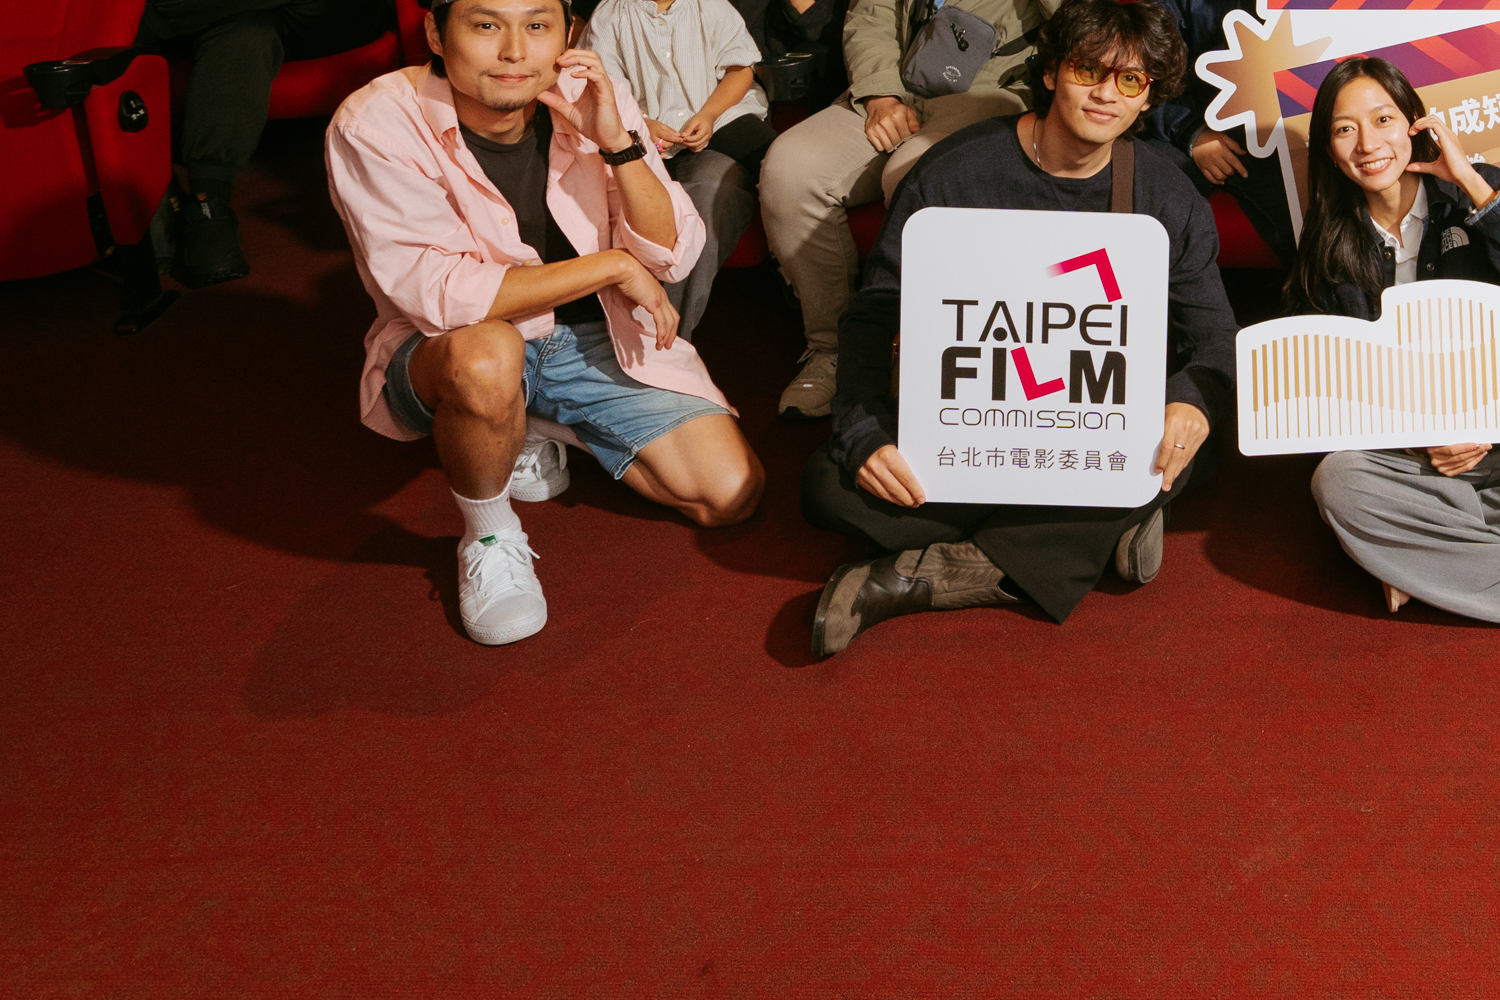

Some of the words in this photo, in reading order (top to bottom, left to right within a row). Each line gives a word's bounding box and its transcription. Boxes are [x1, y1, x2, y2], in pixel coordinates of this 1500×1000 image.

[942, 299, 1128, 346] TAIPEI
[941, 346, 1126, 405] FILM
[939, 407, 1126, 430] COMMISSION
[937, 446, 1127, 471] 台北市電影委員會
